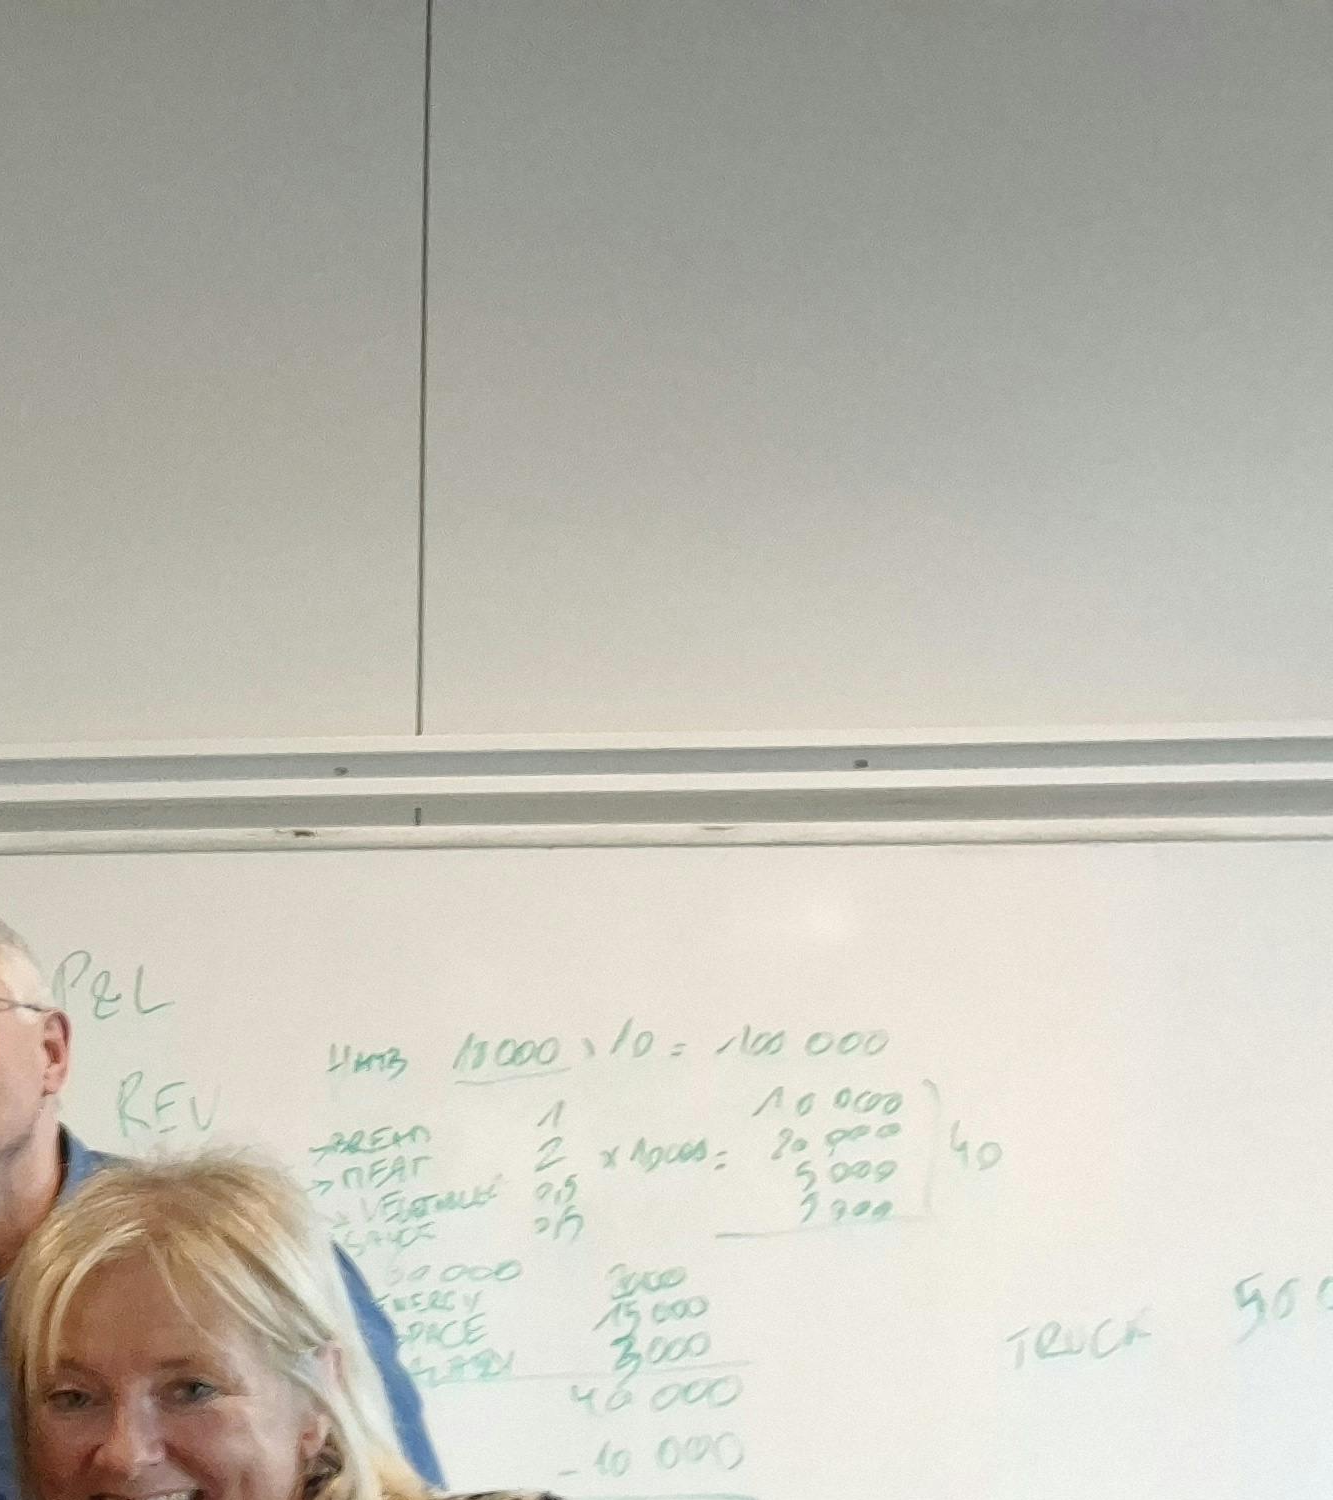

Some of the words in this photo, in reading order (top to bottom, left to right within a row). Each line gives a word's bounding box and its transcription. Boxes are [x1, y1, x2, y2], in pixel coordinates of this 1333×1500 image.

[52, 949, 176, 1020] P&L
[609, 1017, 654, 1060] 10
[341, 1154, 434, 1190] MEAT
[534, 1135, 569, 1173] 2
[948, 1119, 1003, 1172] 40
